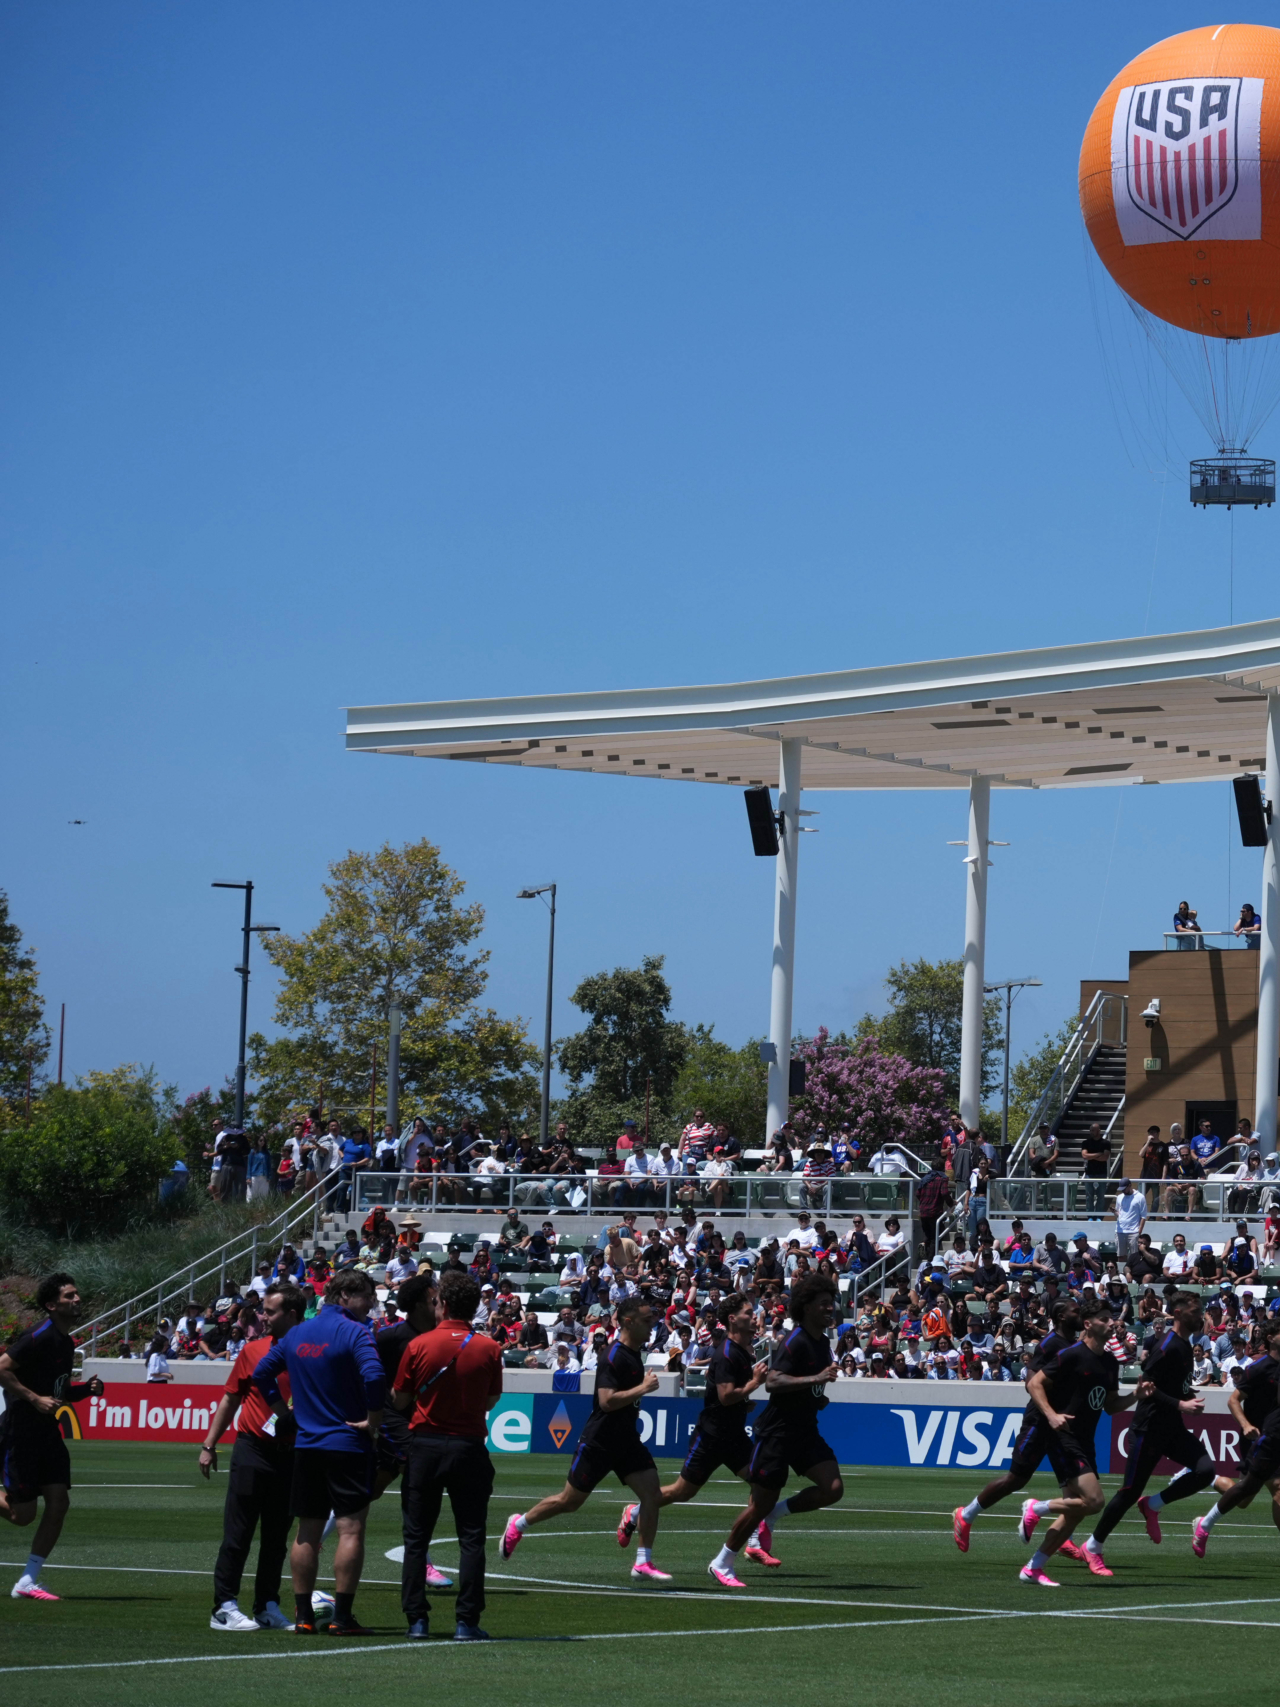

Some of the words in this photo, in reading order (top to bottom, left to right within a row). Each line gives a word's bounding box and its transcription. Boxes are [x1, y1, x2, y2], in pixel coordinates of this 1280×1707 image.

[1134, 85, 1231, 142] USA
[89, 1396, 131, 1427] i'm
[138, 1398, 217, 1430] lovin'
